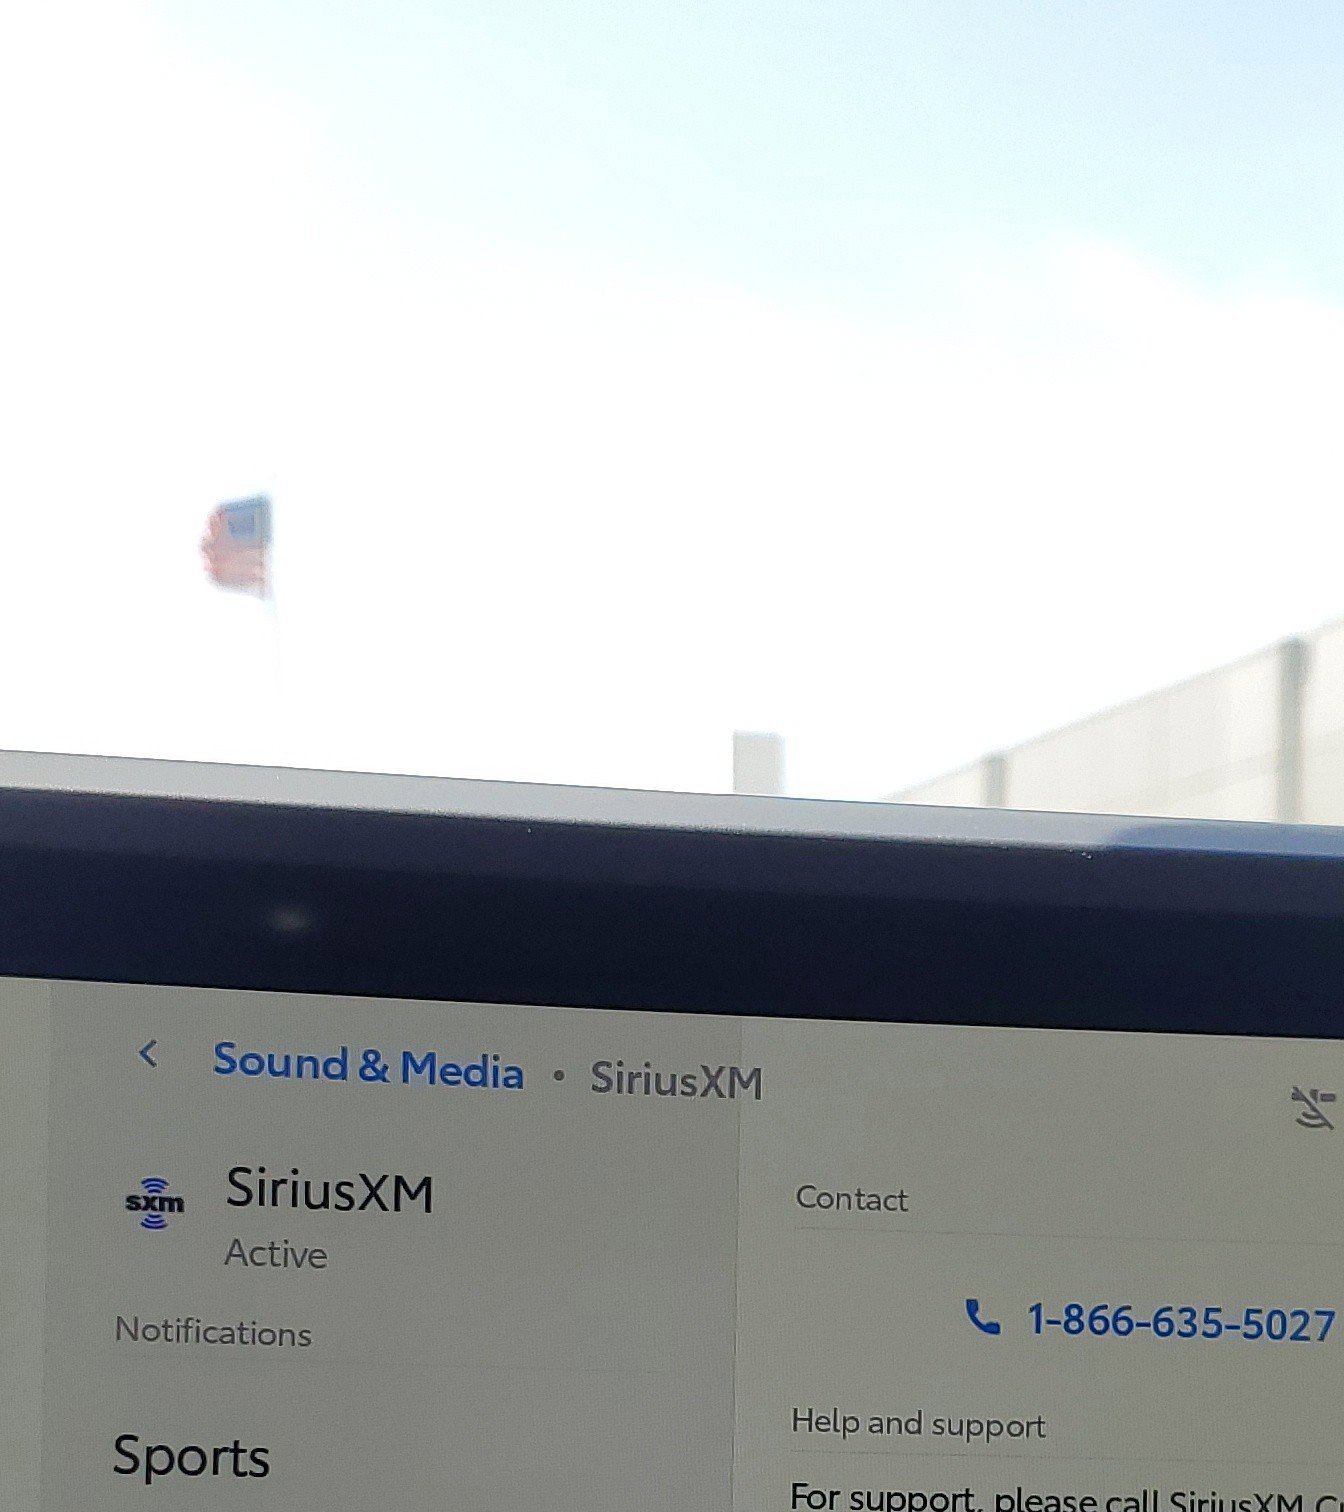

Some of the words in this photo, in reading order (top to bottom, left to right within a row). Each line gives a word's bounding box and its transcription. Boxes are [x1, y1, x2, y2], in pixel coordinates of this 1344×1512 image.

[213, 1041, 349, 1081] Sound
[358, 1051, 389, 1083] &
[401, 1050, 524, 1090] Media
[590, 1059, 762, 1101] SiriusXM
[226, 1166, 433, 1214] SiriusXM
[795, 1184, 909, 1213] Contact
[223, 1237, 328, 1270] Active
[115, 1315, 312, 1348] Notifications
[1029, 1302, 1336, 1342] 1-866-635-5027
[792, 1407, 861, 1441] Help
[867, 1409, 923, 1436] and
[932, 1415, 1047, 1444] support
[113, 1433, 270, 1486] Sports
[791, 1482, 841, 1511] For
